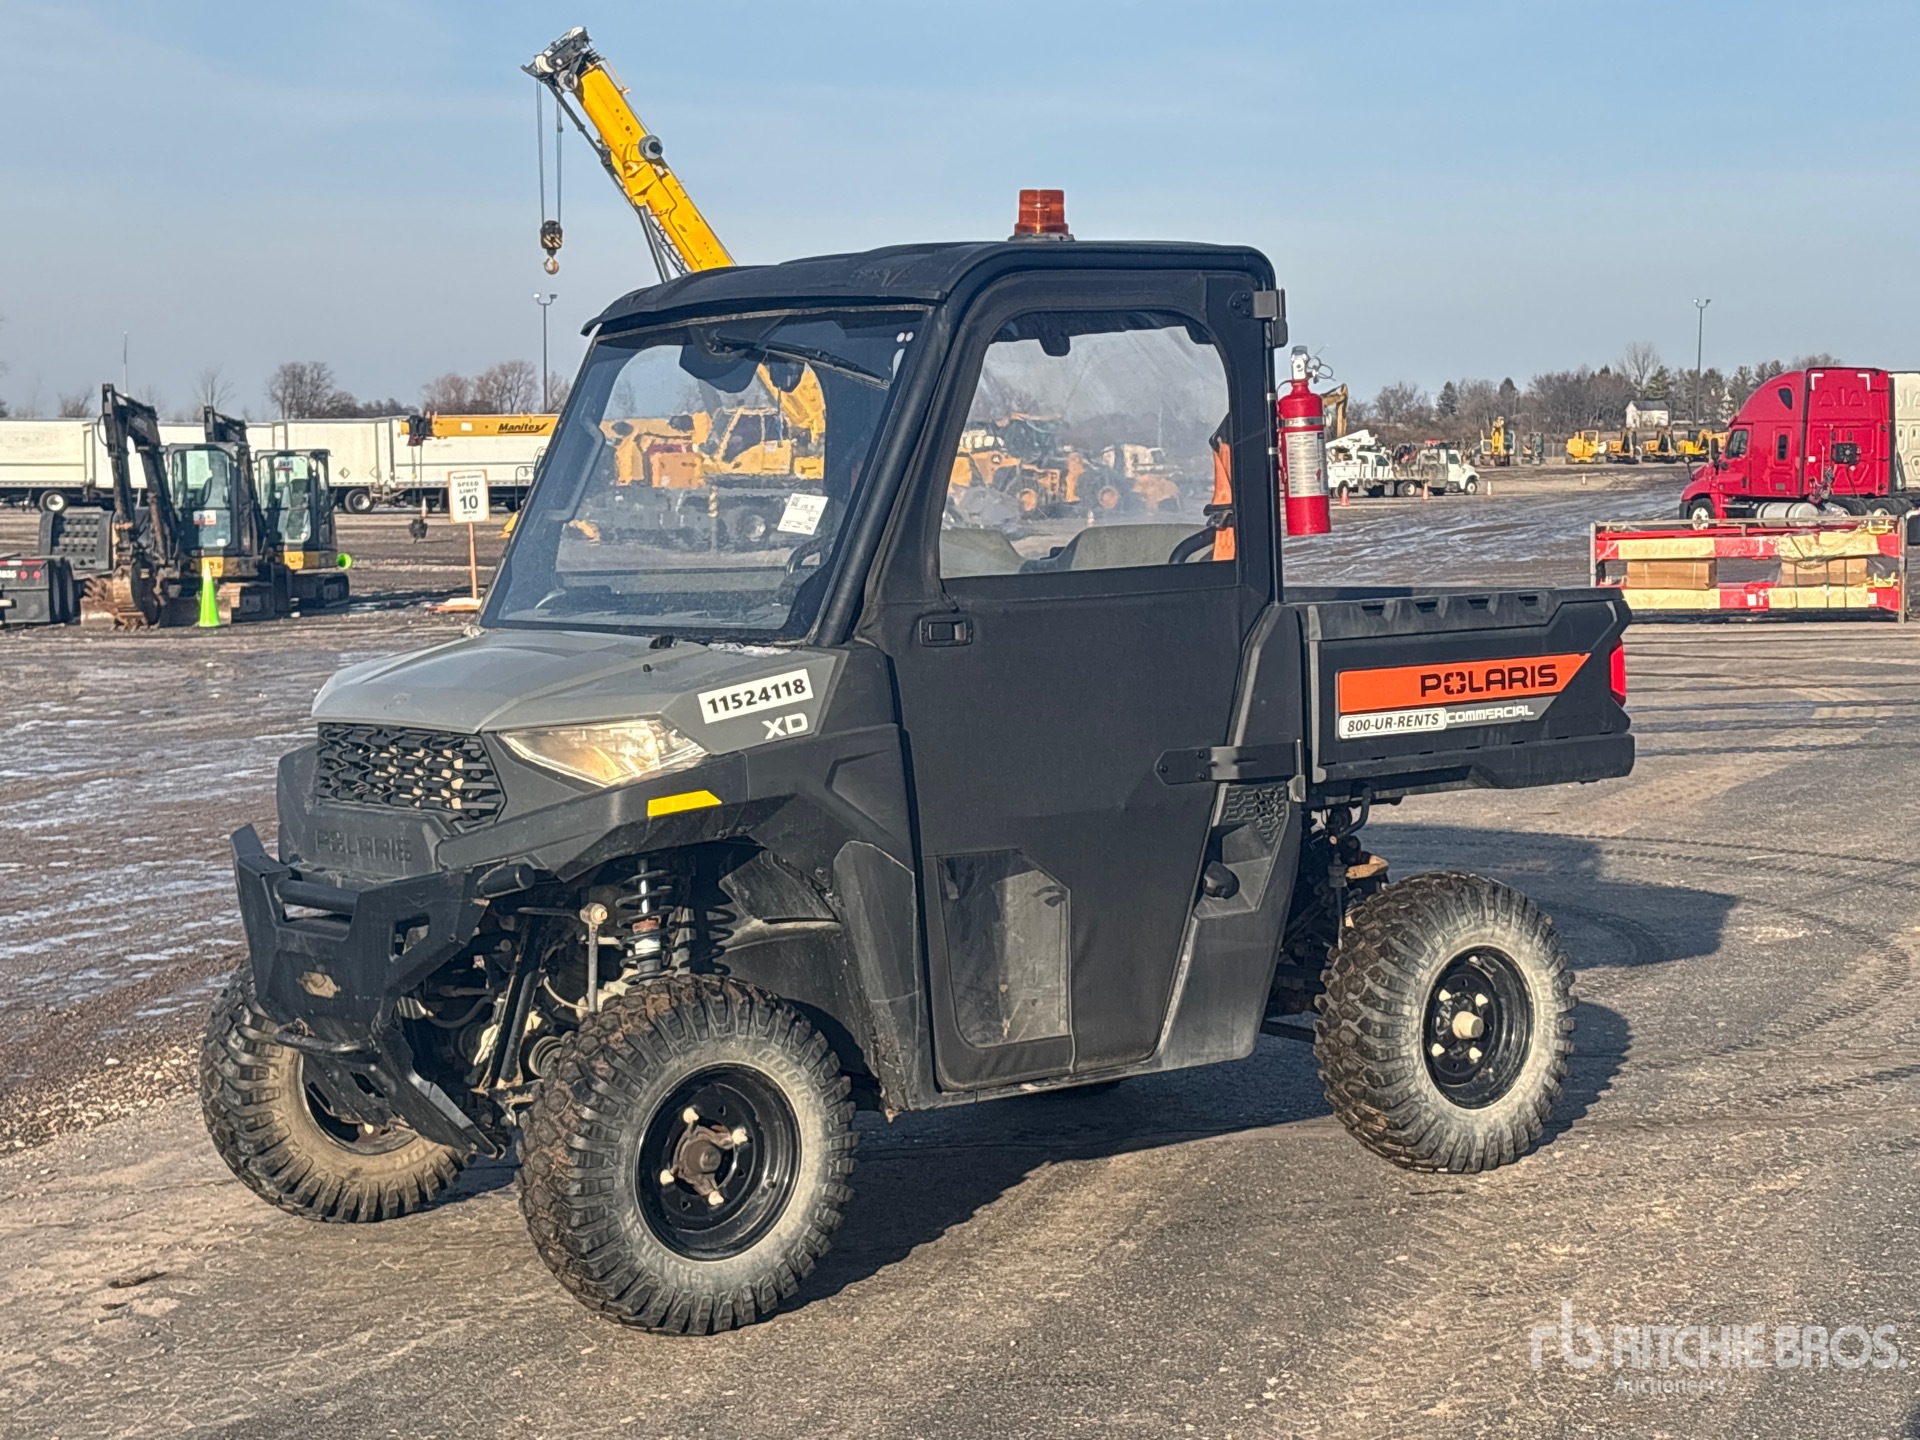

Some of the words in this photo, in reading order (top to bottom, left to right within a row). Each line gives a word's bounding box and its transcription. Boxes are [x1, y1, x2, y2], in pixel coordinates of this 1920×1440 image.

[498, 422, 546, 433] Manitex
[460, 495, 478, 510] 10
[1420, 664, 1558, 698] POLARIS
[707, 678, 806, 714] 11524118
[761, 712, 809, 740] XD
[1347, 712, 1440, 733] 800-UR-RENTS
[1446, 704, 1535, 724] COMMERCIAL
[315, 830, 412, 862] POLARIS
